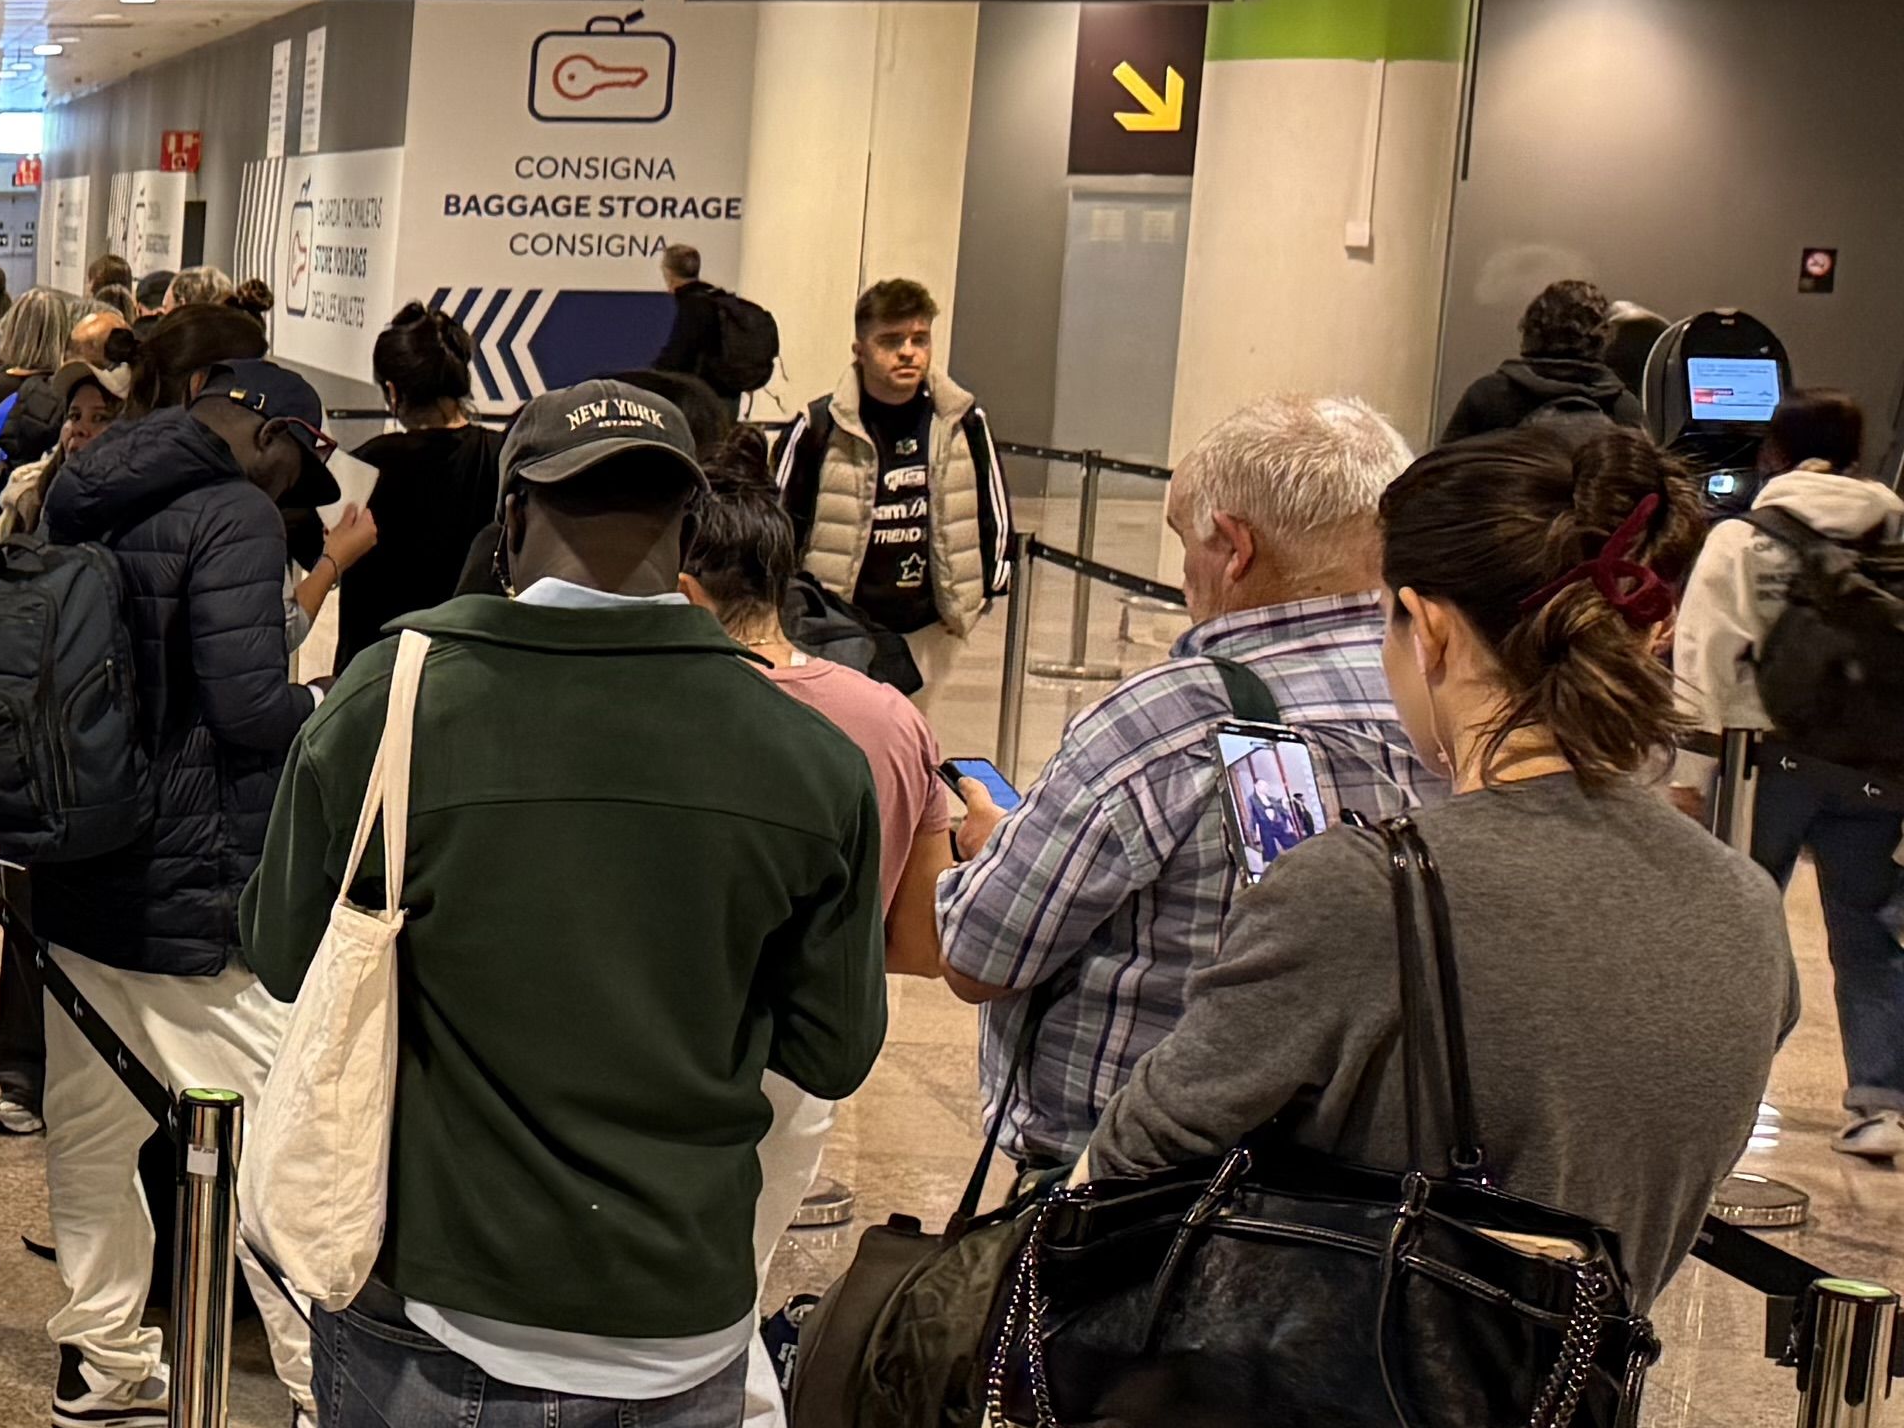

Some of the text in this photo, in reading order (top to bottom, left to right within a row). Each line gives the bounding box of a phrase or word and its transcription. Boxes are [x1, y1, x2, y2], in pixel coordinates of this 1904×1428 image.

[514, 156, 676, 181] CONSIGNA
[443, 193, 742, 220] BAGGAGE STORAGE
[509, 232, 667, 258] CONSIGNA
[565, 398, 666, 431] NEW YORK
